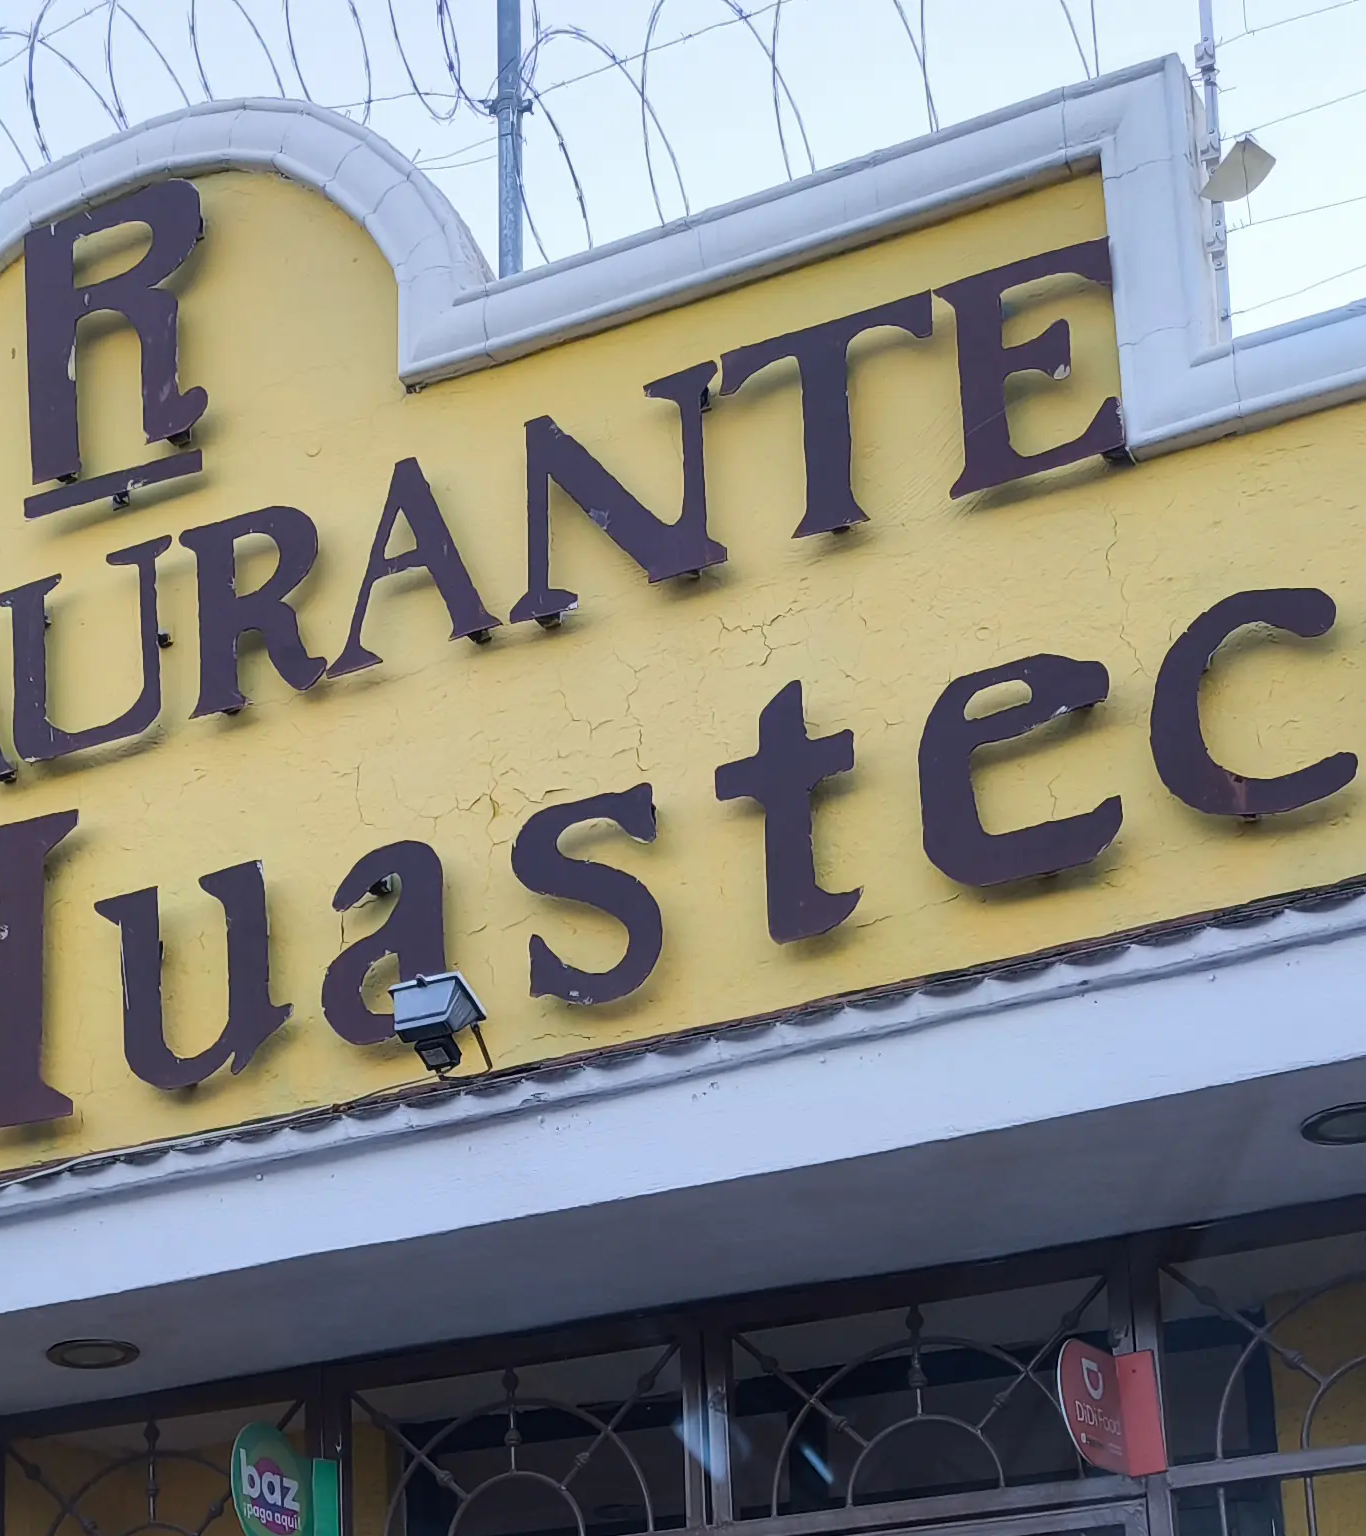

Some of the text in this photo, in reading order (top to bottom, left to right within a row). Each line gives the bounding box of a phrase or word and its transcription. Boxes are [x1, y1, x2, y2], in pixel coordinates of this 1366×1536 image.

[1075, 1400, 1121, 1436] DiDi Food
[239, 1447, 300, 1511] baz
[243, 1502, 273, 1524] ¡paga
